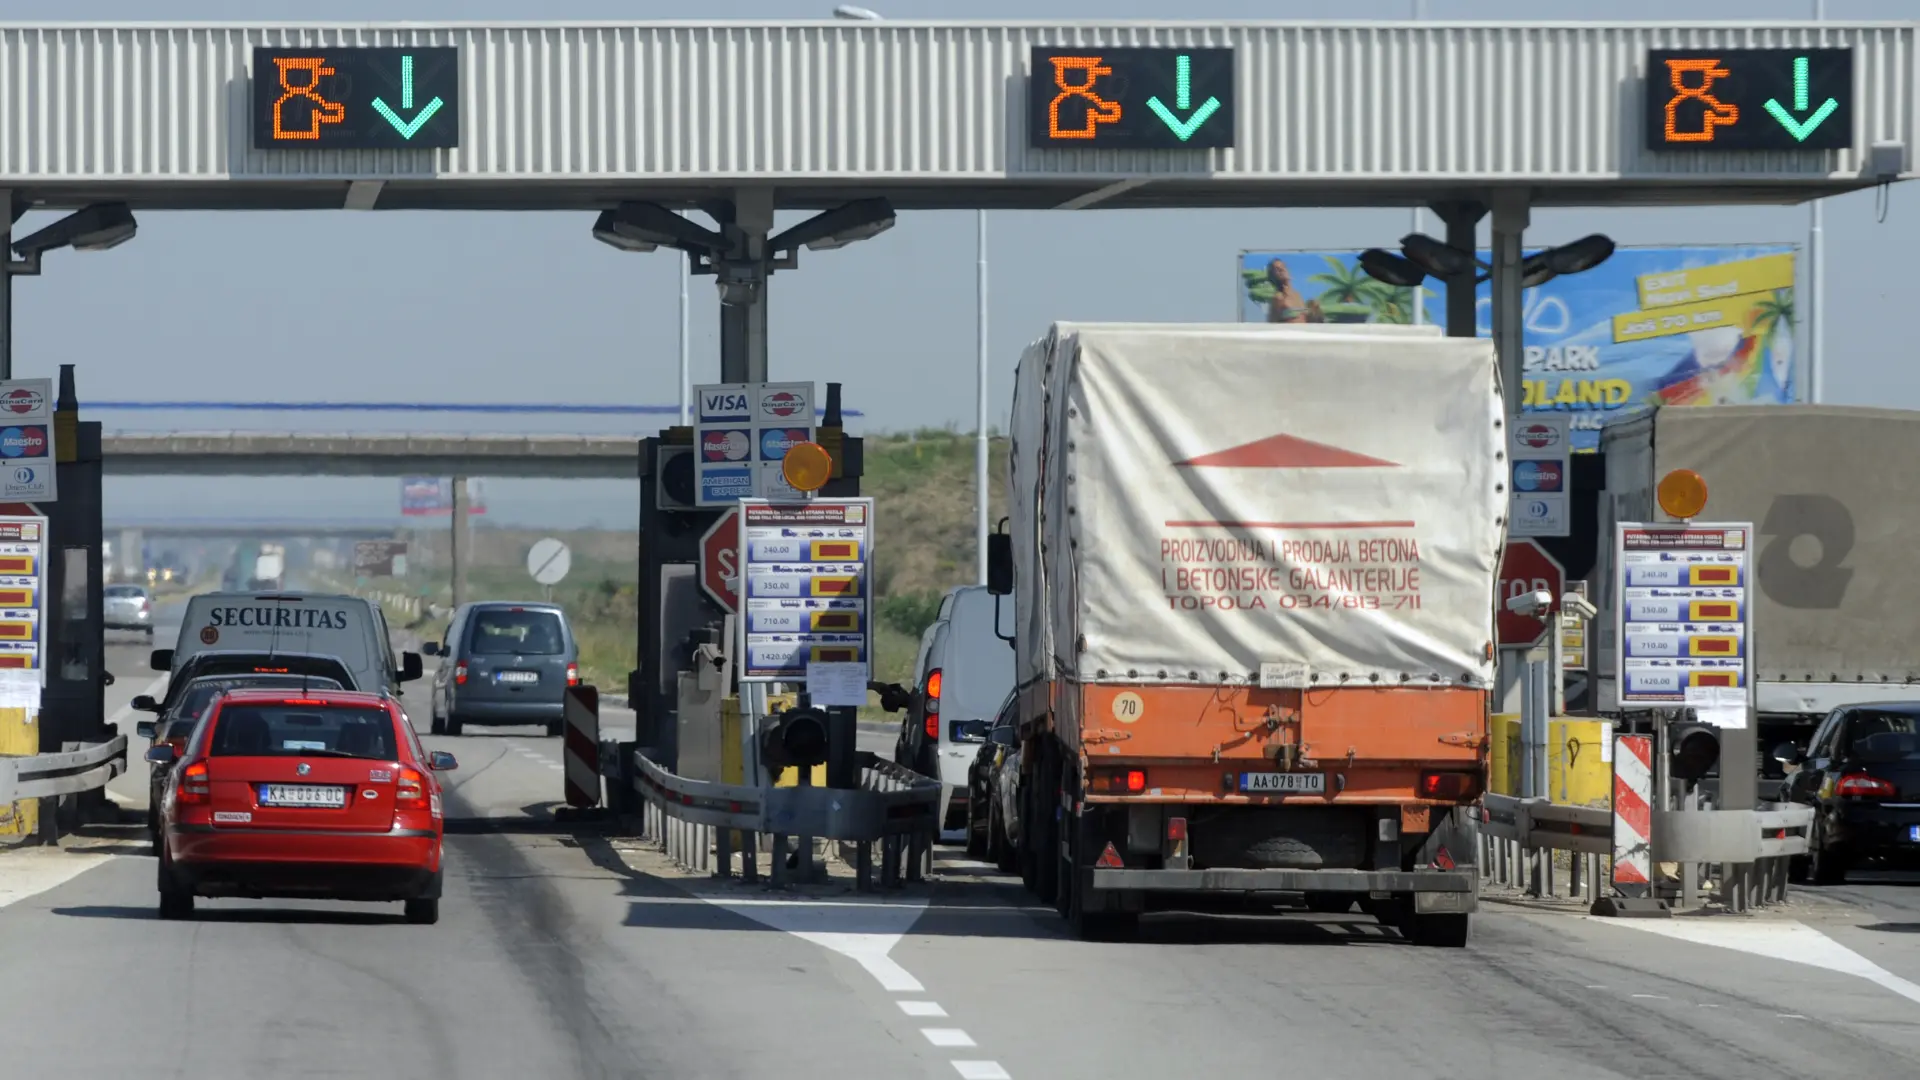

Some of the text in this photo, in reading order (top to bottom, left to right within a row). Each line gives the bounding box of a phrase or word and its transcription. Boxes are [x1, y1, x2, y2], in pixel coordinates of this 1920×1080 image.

[1661, 314, 1688, 328] 70
[1523, 345, 1601, 371] PARK
[705, 394, 748, 411] VISA
[3, 437, 42, 446] Maestro
[702, 475, 750, 486] AMERICAN
[711, 486, 752, 497] EXPRESS
[763, 546, 790, 554] 240.00
[1160, 538, 1420, 564] PROIZVODNJA I PRODAJA BETONA
[1161, 567, 1420, 592] I BETONSKE GALANTERIJE
[763, 582, 790, 590] 350.00
[1164, 593, 1421, 611] TOPOLA 034/813-711
[1641, 606, 1668, 614] 350.00
[209, 607, 348, 630] SECURITAS
[763, 617, 790, 625] 710.00
[1641, 641, 1668, 650] 710.00
[761, 652, 793, 661] 1420.00
[1639, 677, 1670, 686] 1420.00
[1121, 699, 1136, 716] 70
